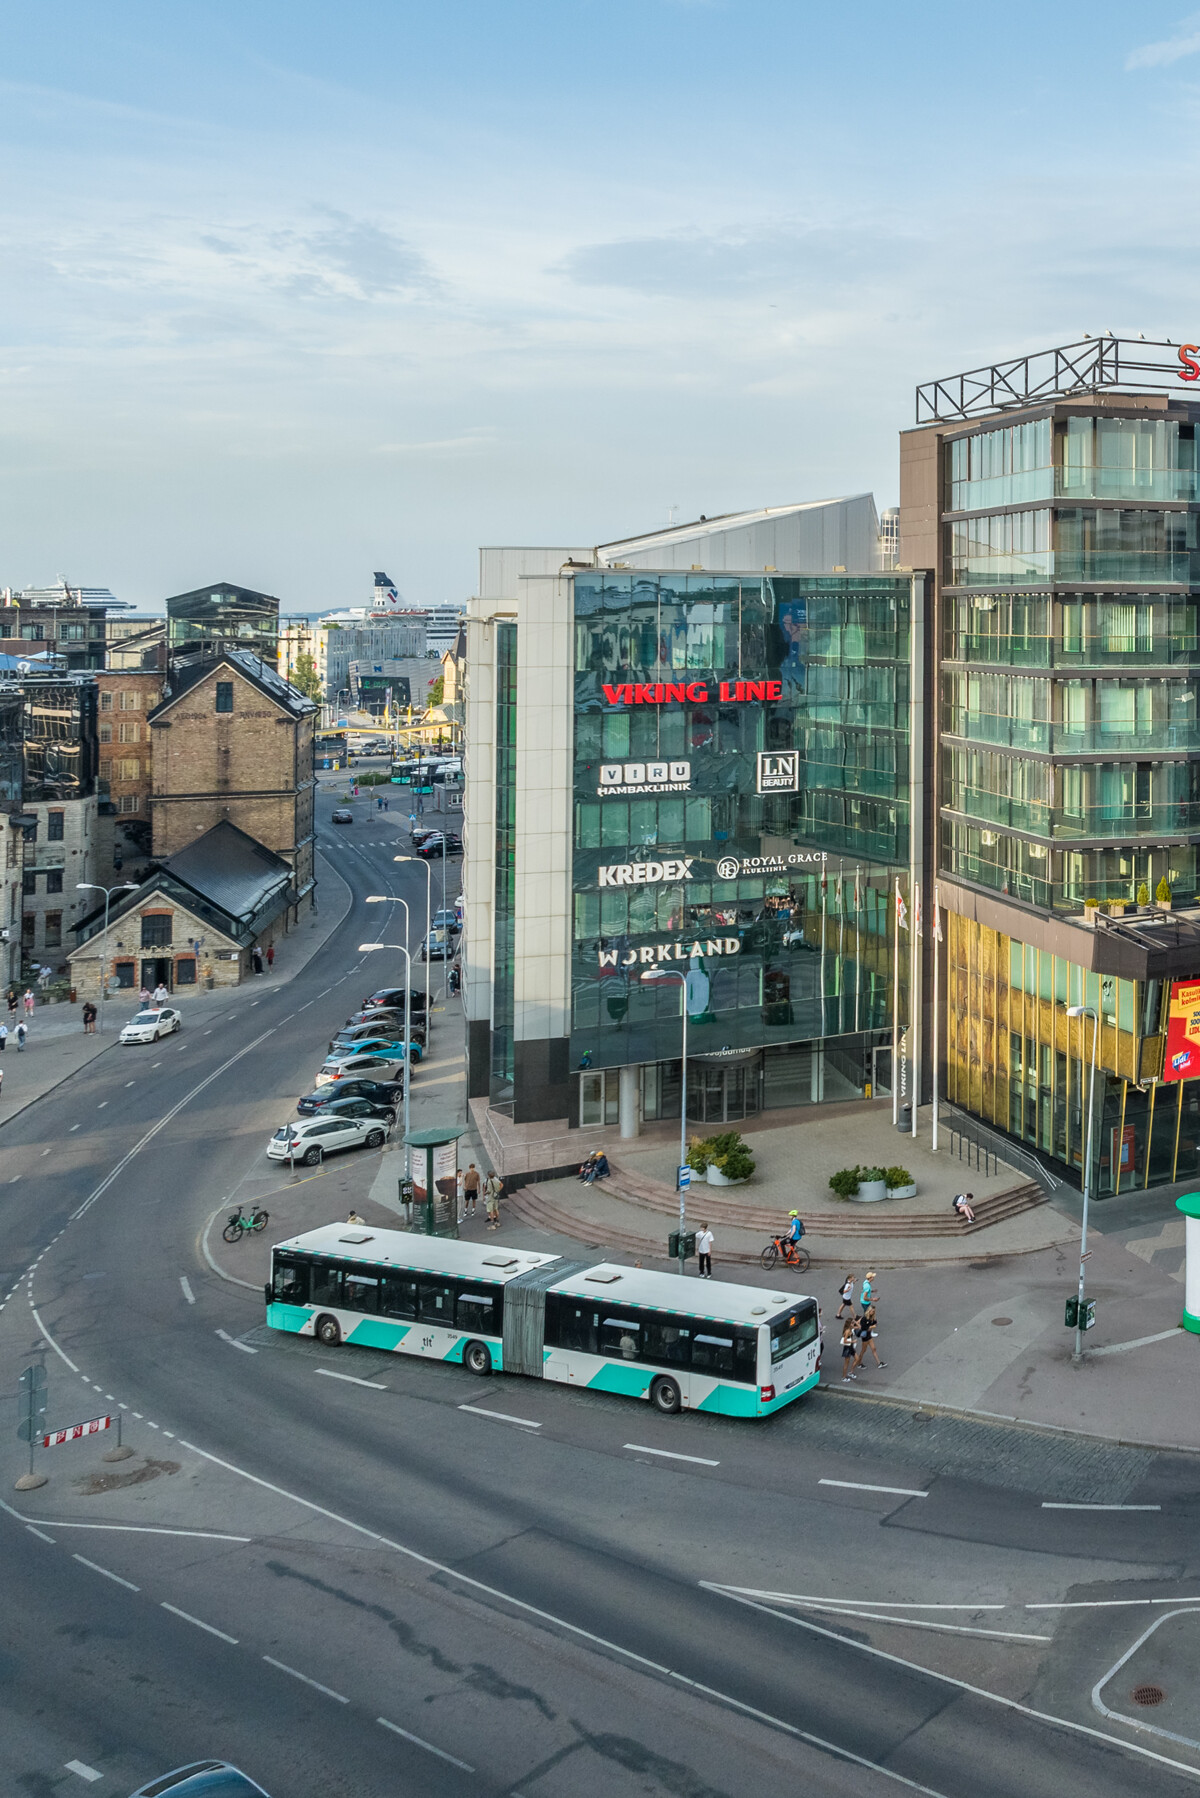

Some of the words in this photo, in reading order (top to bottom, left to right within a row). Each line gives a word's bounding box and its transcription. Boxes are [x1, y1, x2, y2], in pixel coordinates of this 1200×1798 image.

[601, 682, 708, 704] VIKING
[719, 681, 782, 702] LINE
[605, 765, 687, 781] VIRU
[763, 757, 794, 775] LN
[762, 778, 793, 787] BEAUTY
[597, 783, 691, 797] HAMBAKLIINIK
[743, 856, 784, 867] ROYAL
[788, 852, 828, 863] GRACE
[599, 859, 694, 886] KREDEX
[1189, 1026, 1200, 1035] LIDL
[1174, 1054, 1187, 1066] Lidl
[422, 1336, 433, 1348] tlt
